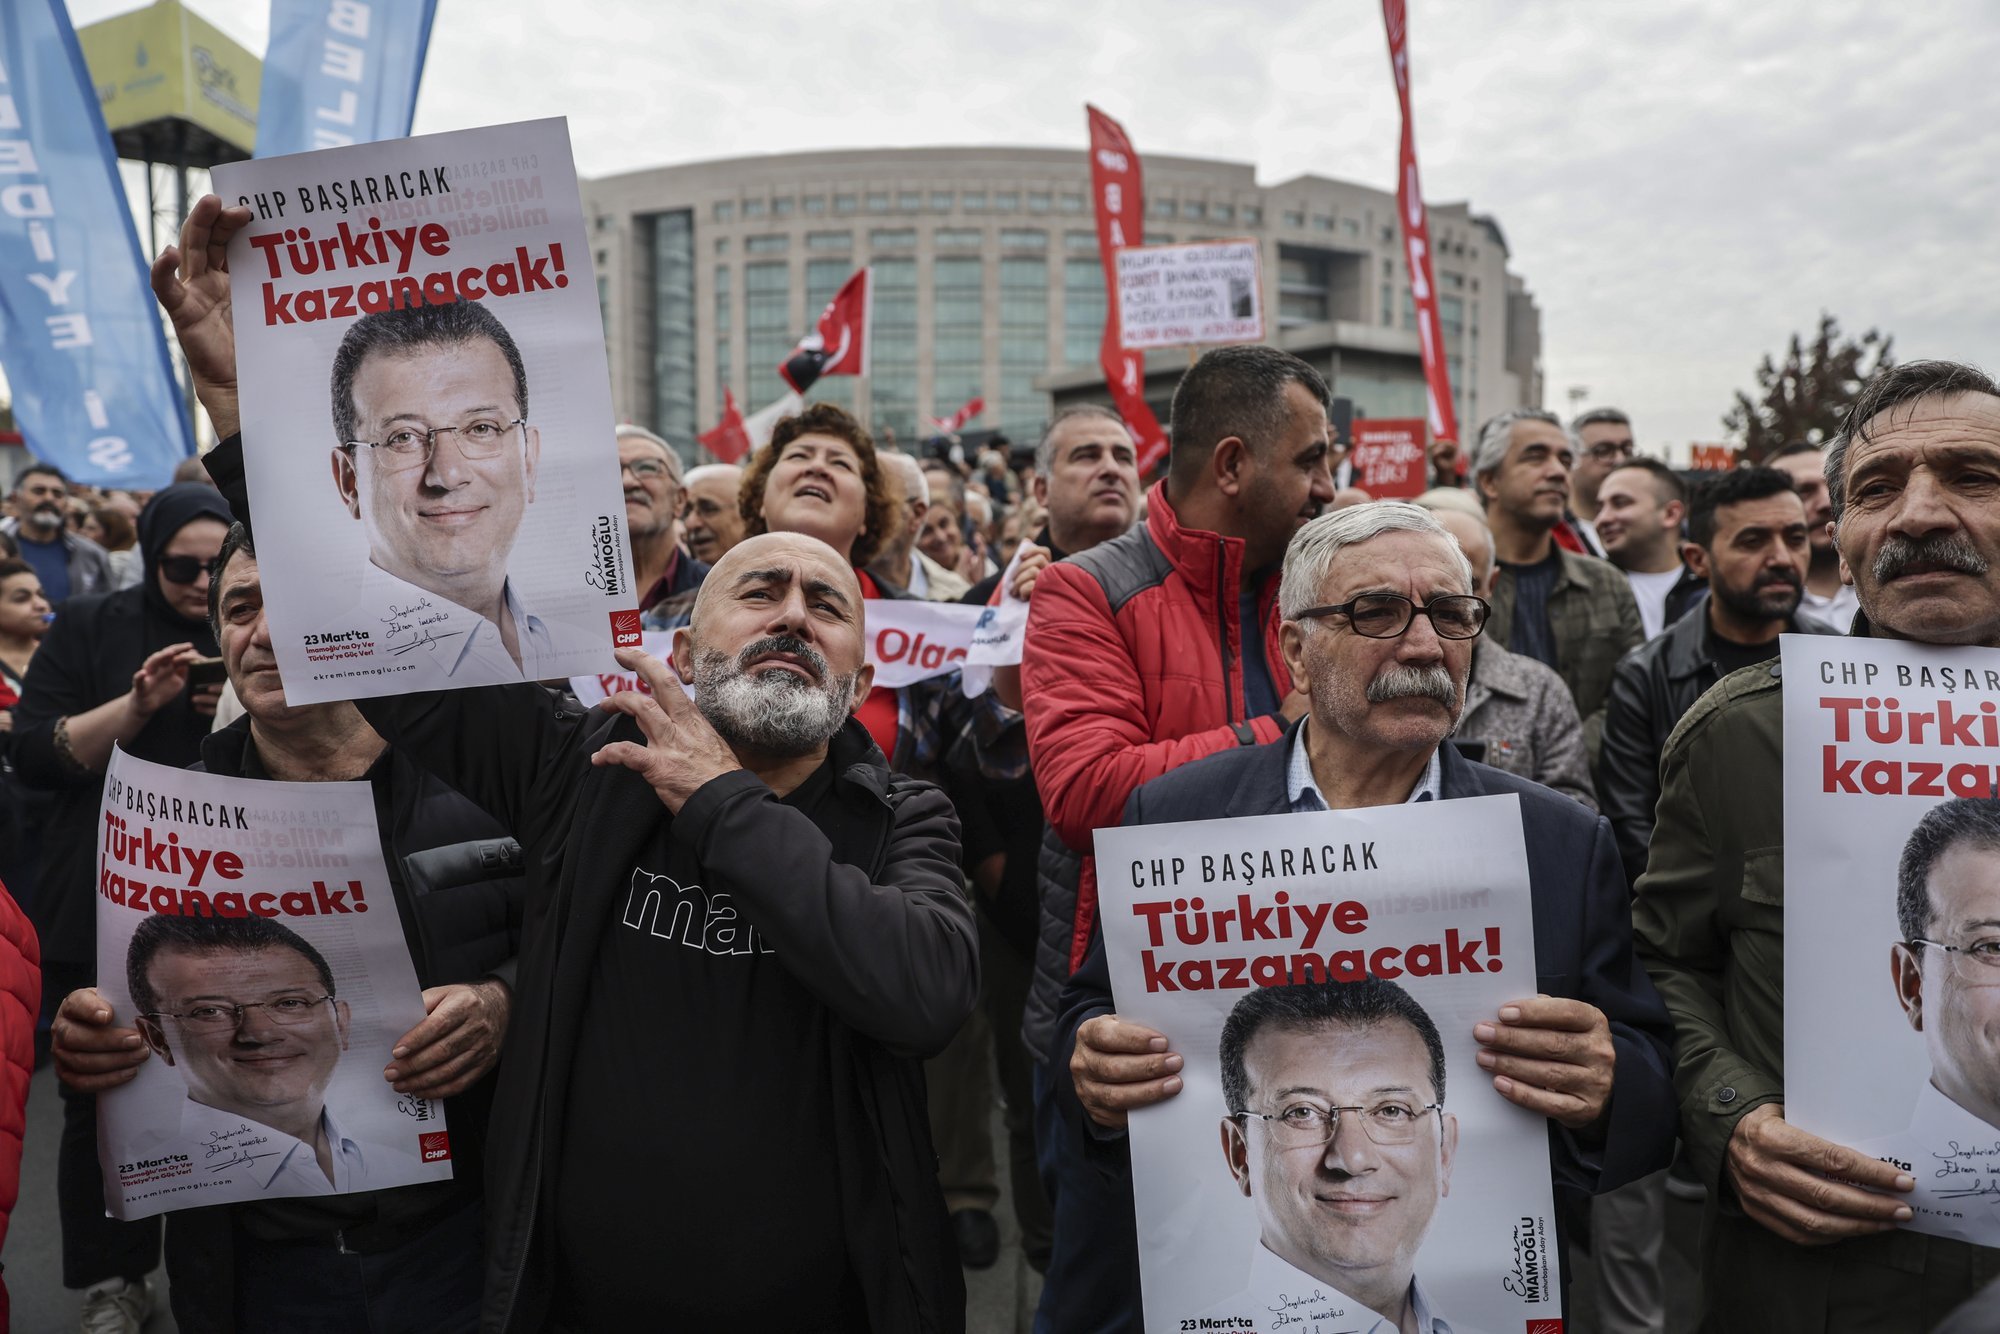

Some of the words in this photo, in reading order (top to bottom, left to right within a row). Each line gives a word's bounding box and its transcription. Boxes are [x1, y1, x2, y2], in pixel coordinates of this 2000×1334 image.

[298, 167, 450, 214] BAŞARACAK
[250, 217, 450, 278] Türkiye
[262, 243, 569, 325] kazanacak!
[598, 516, 618, 596] İMAMOĞLU
[304, 636, 319, 645] 23
[321, 630, 369, 644] Mart'ta
[617, 633, 639, 643] CHP
[313, 664, 416, 680] ekremimamoglu.com
[1820, 661, 1879, 685] CHP
[1822, 745, 2000, 799] kaza
[108, 774, 122, 805] CHP
[127, 785, 248, 830] BAŞARACAK
[105, 809, 244, 887] Türkiye
[1131, 857, 1185, 888] CHP
[1201, 841, 1378, 886] BAŞARACAK
[100, 852, 369, 918] kazanacak!
[623, 867, 775, 956] ma
[1132, 890, 1369, 950] Türkiye
[1140, 926, 1504, 993] kazanacak!
[118, 1164, 134, 1173] 23
[137, 1154, 188, 1170] Mart'ta
[425, 1150, 447, 1159] CHP
[1521, 1217, 1540, 1303] İMAMOĞLU
[1180, 1319, 1197, 1331] 23
[1200, 1316, 1253, 1330] Mart'ta
